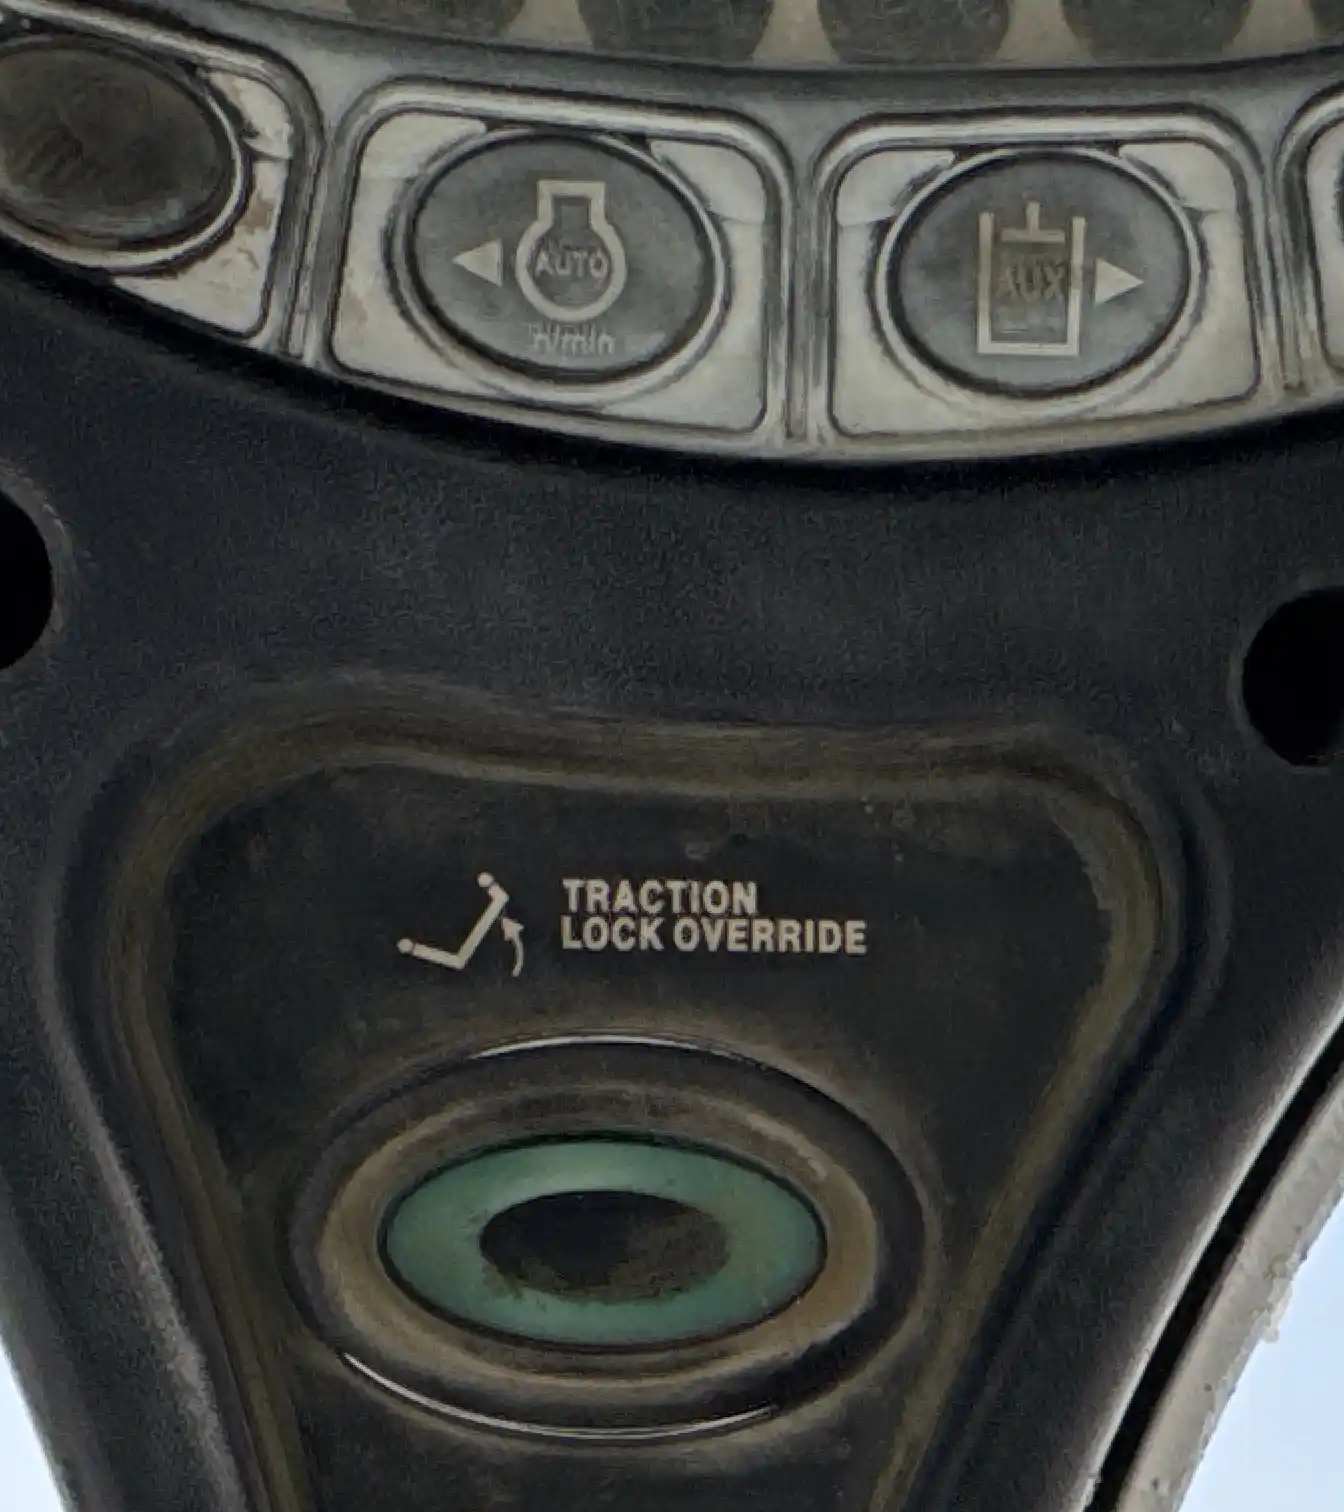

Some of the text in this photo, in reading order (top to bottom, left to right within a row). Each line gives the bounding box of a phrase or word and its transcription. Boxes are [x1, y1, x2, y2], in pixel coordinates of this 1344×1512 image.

[535, 249, 608, 280] AUTO
[562, 878, 758, 915] TRACTION
[560, 916, 869, 955] LOCK OVERRIDE
